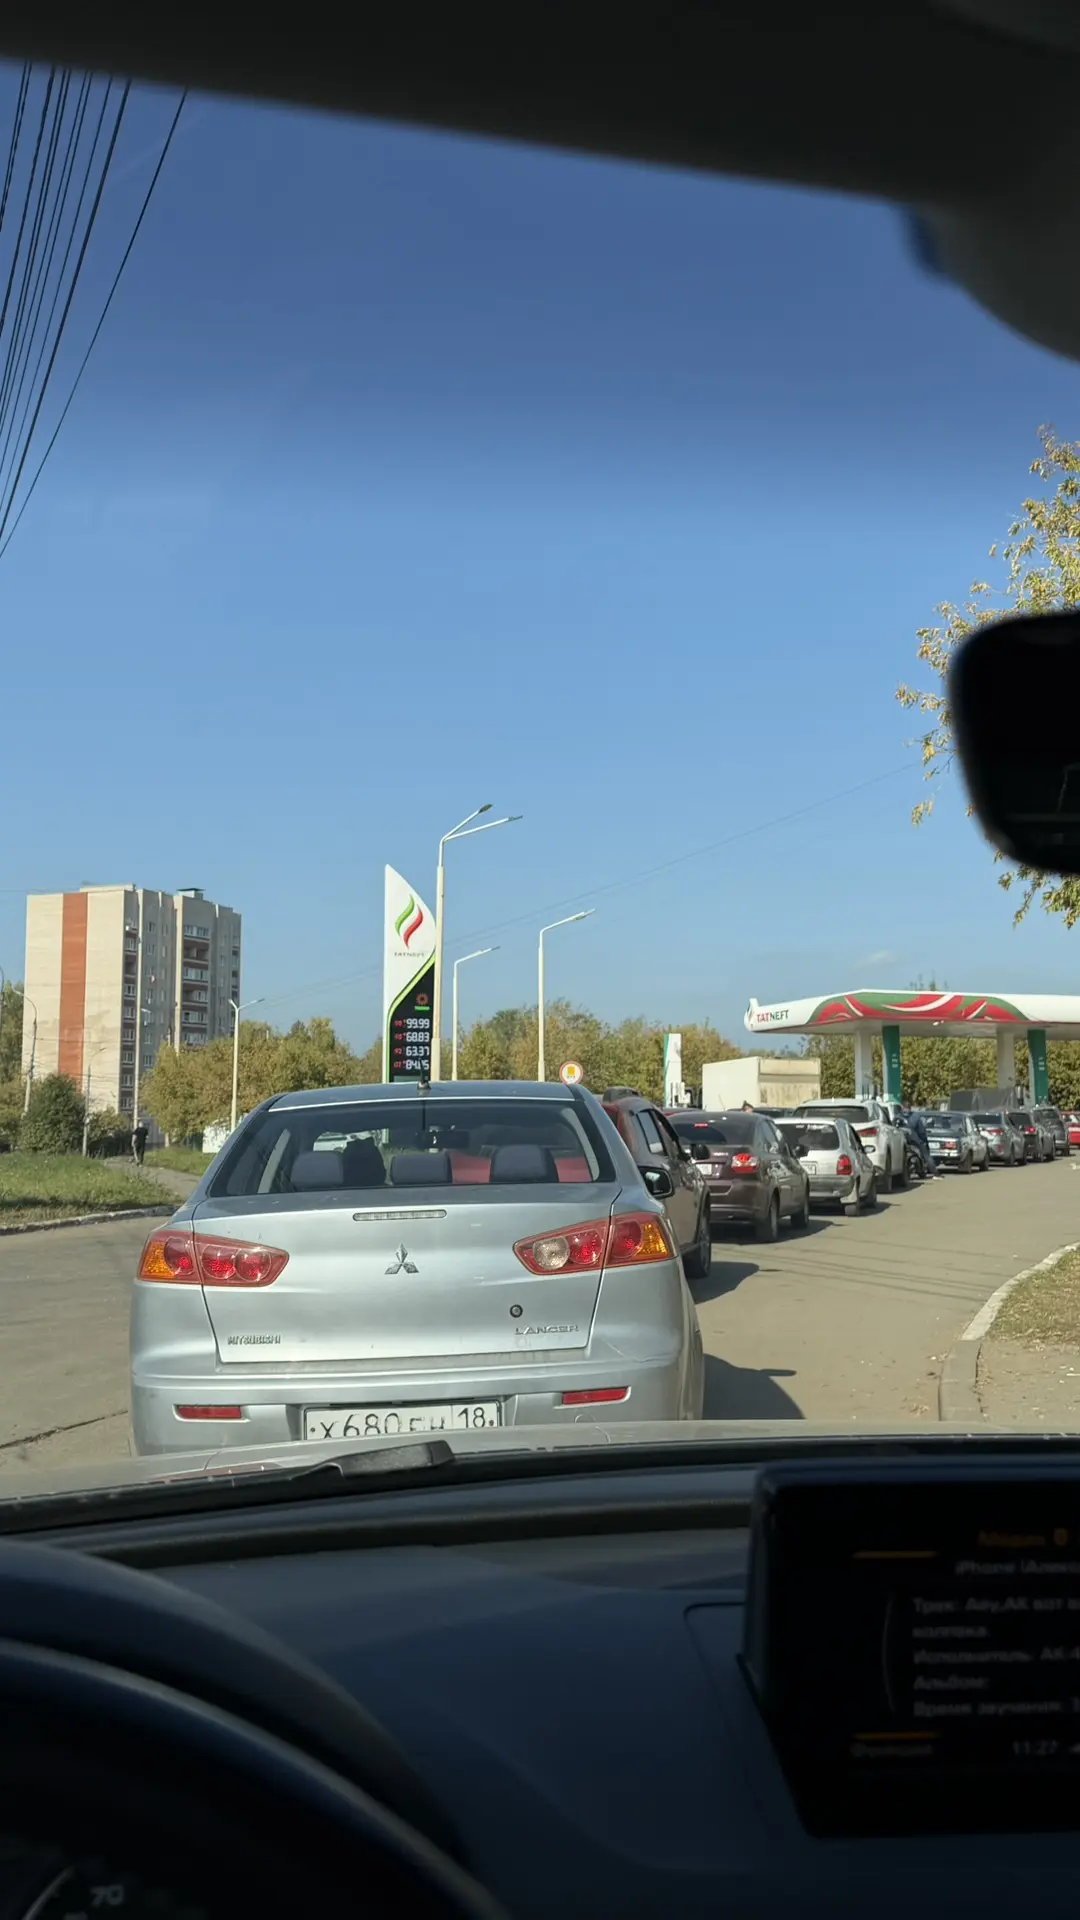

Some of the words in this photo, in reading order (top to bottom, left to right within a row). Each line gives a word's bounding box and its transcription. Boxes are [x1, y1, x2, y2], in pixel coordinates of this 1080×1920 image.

[757, 1009, 788, 1023] TATNEFT
[406, 1018, 430, 1029] 99.99
[406, 1032, 430, 1042] 68.83
[405, 1046, 430, 1057] 63.37
[514, 1323, 579, 1335] LANCER
[227, 1334, 281, 1346] MITSUBISHI
[457, 1406, 486, 1429] 18
[89, 1883, 125, 1909] 70
